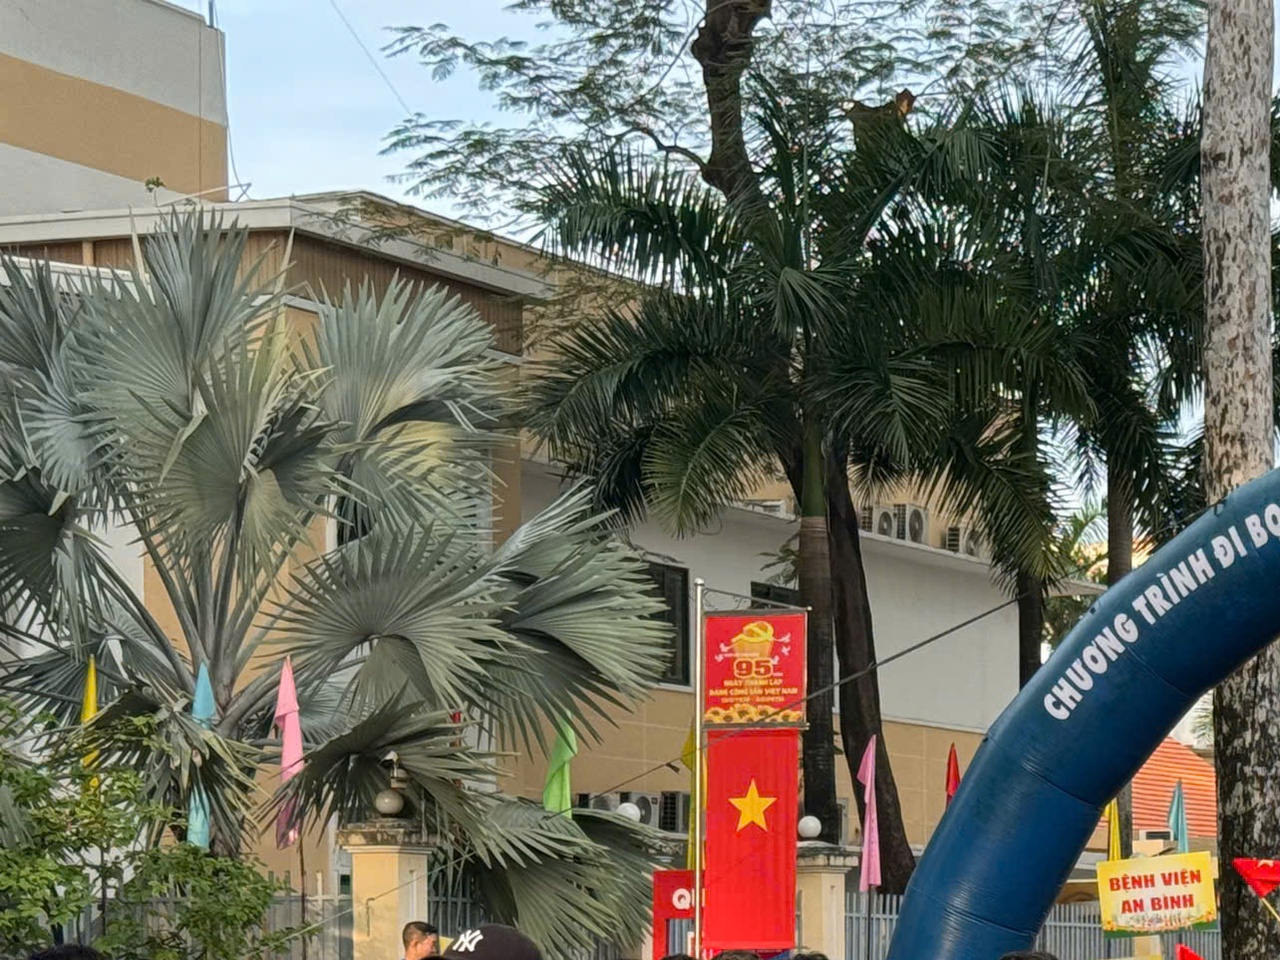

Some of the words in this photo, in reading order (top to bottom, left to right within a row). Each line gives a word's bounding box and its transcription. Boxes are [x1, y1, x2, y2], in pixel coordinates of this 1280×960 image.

[1043, 612, 1140, 721] CHƯƠNG
[1131, 547, 1217, 626] TRÌNH
[1211, 525, 1248, 569] ĐI
[733, 657, 774, 679] 95
[1108, 872, 1156, 894] BỆNH
[1161, 867, 1203, 888] VIỆN
[1121, 898, 1145, 915] AN
[1150, 893, 1195, 912] BÌNH
